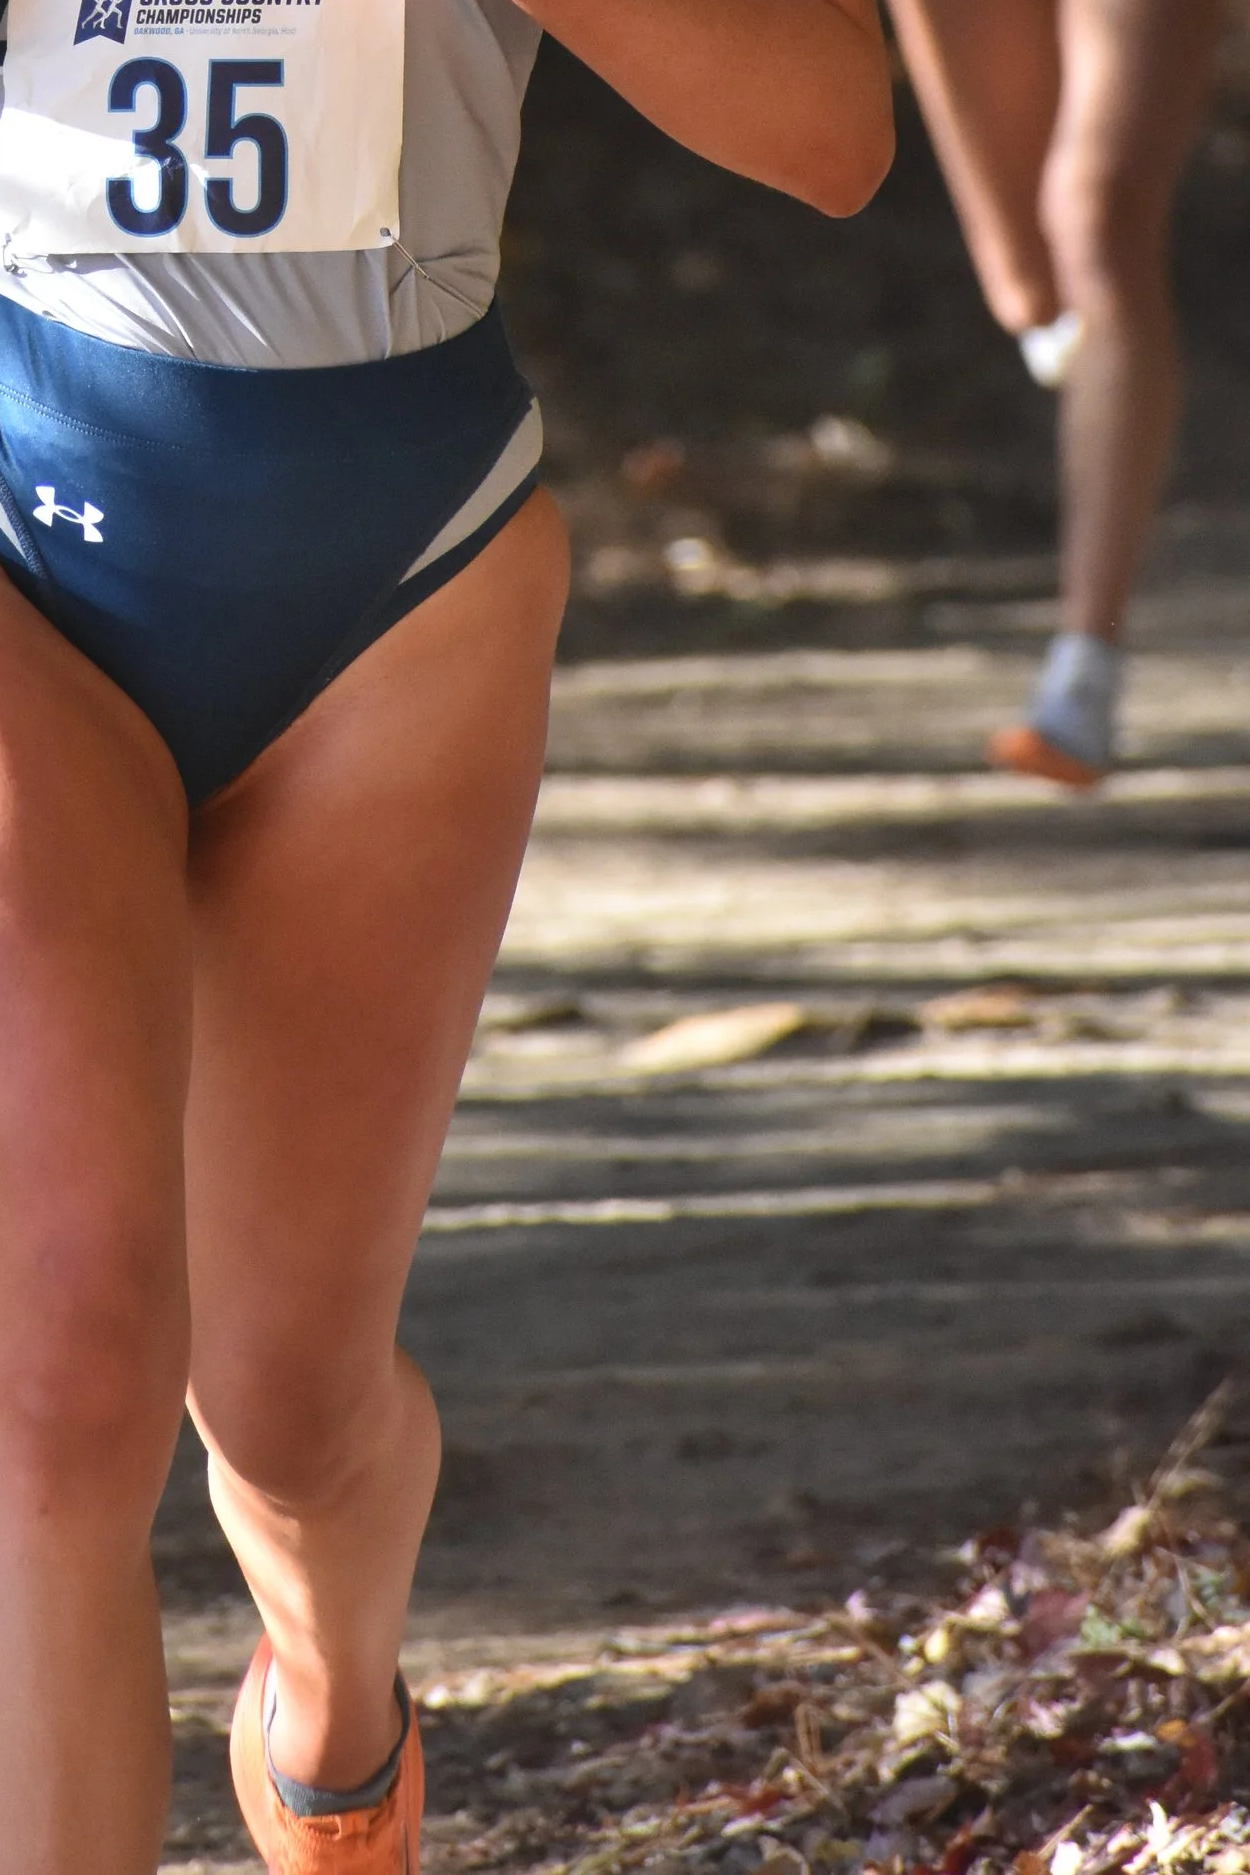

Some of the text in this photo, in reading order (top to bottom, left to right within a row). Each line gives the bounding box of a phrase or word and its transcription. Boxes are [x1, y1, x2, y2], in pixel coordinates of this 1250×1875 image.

[136, 8, 262, 25] CHAMPIONSHIPS
[133, 27, 173, 36] OAKWOOD,
[174, 27, 184, 35] GA
[105, 56, 289, 239] 35
